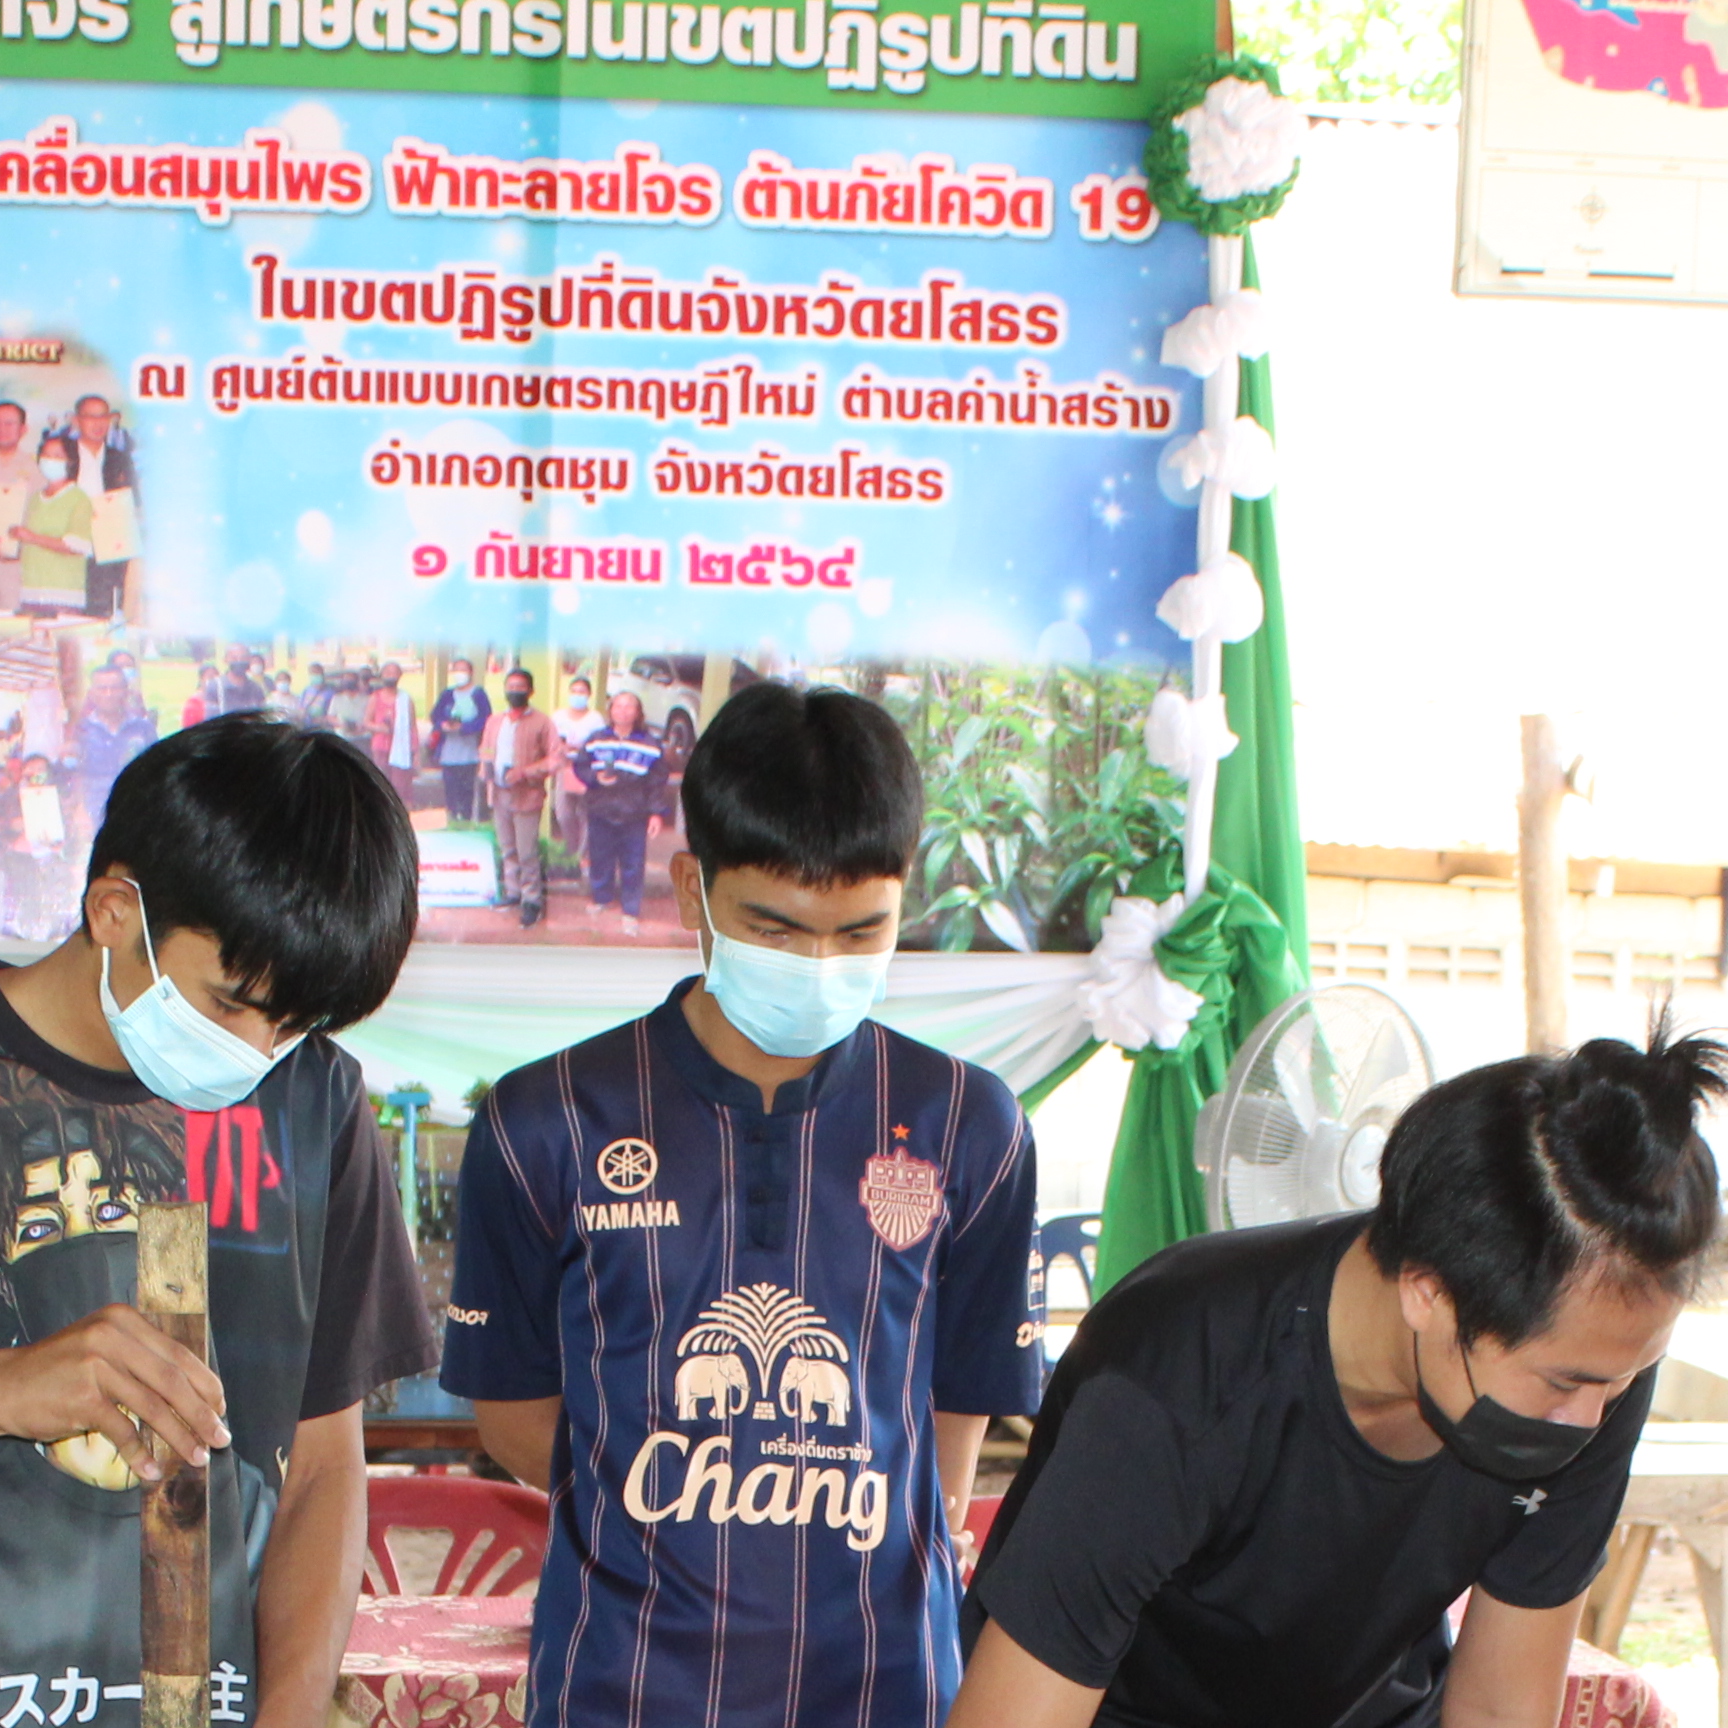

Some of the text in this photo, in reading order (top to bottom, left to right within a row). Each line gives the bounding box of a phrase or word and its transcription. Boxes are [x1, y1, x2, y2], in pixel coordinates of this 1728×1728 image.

[392, 149, 712, 215] ฟ้าทะลายโจร
[743, 160, 1043, 228] ต้านภัยโควิด
[1080, 183, 1153, 232] 19
[252, 256, 1058, 345] ในเขตปฏิรูปที่ดินจังหวัดยโสธร
[139, 356, 1170, 429] ณ ศูนย์ต้นแบบเกษตรทฤษฎีใหม่ ตำบลคำน้ำสร้าง
[371, 440, 943, 503] อำเภอกุดชุม จังหวัดยโสธร
[413, 531, 855, 586] ๑ กันยายน ๒๕๖๔
[582, 1200, 680, 1232] YAMAHA
[872, 1189, 931, 1206] BURIRAM
[624, 1431, 888, 1552] Chang
